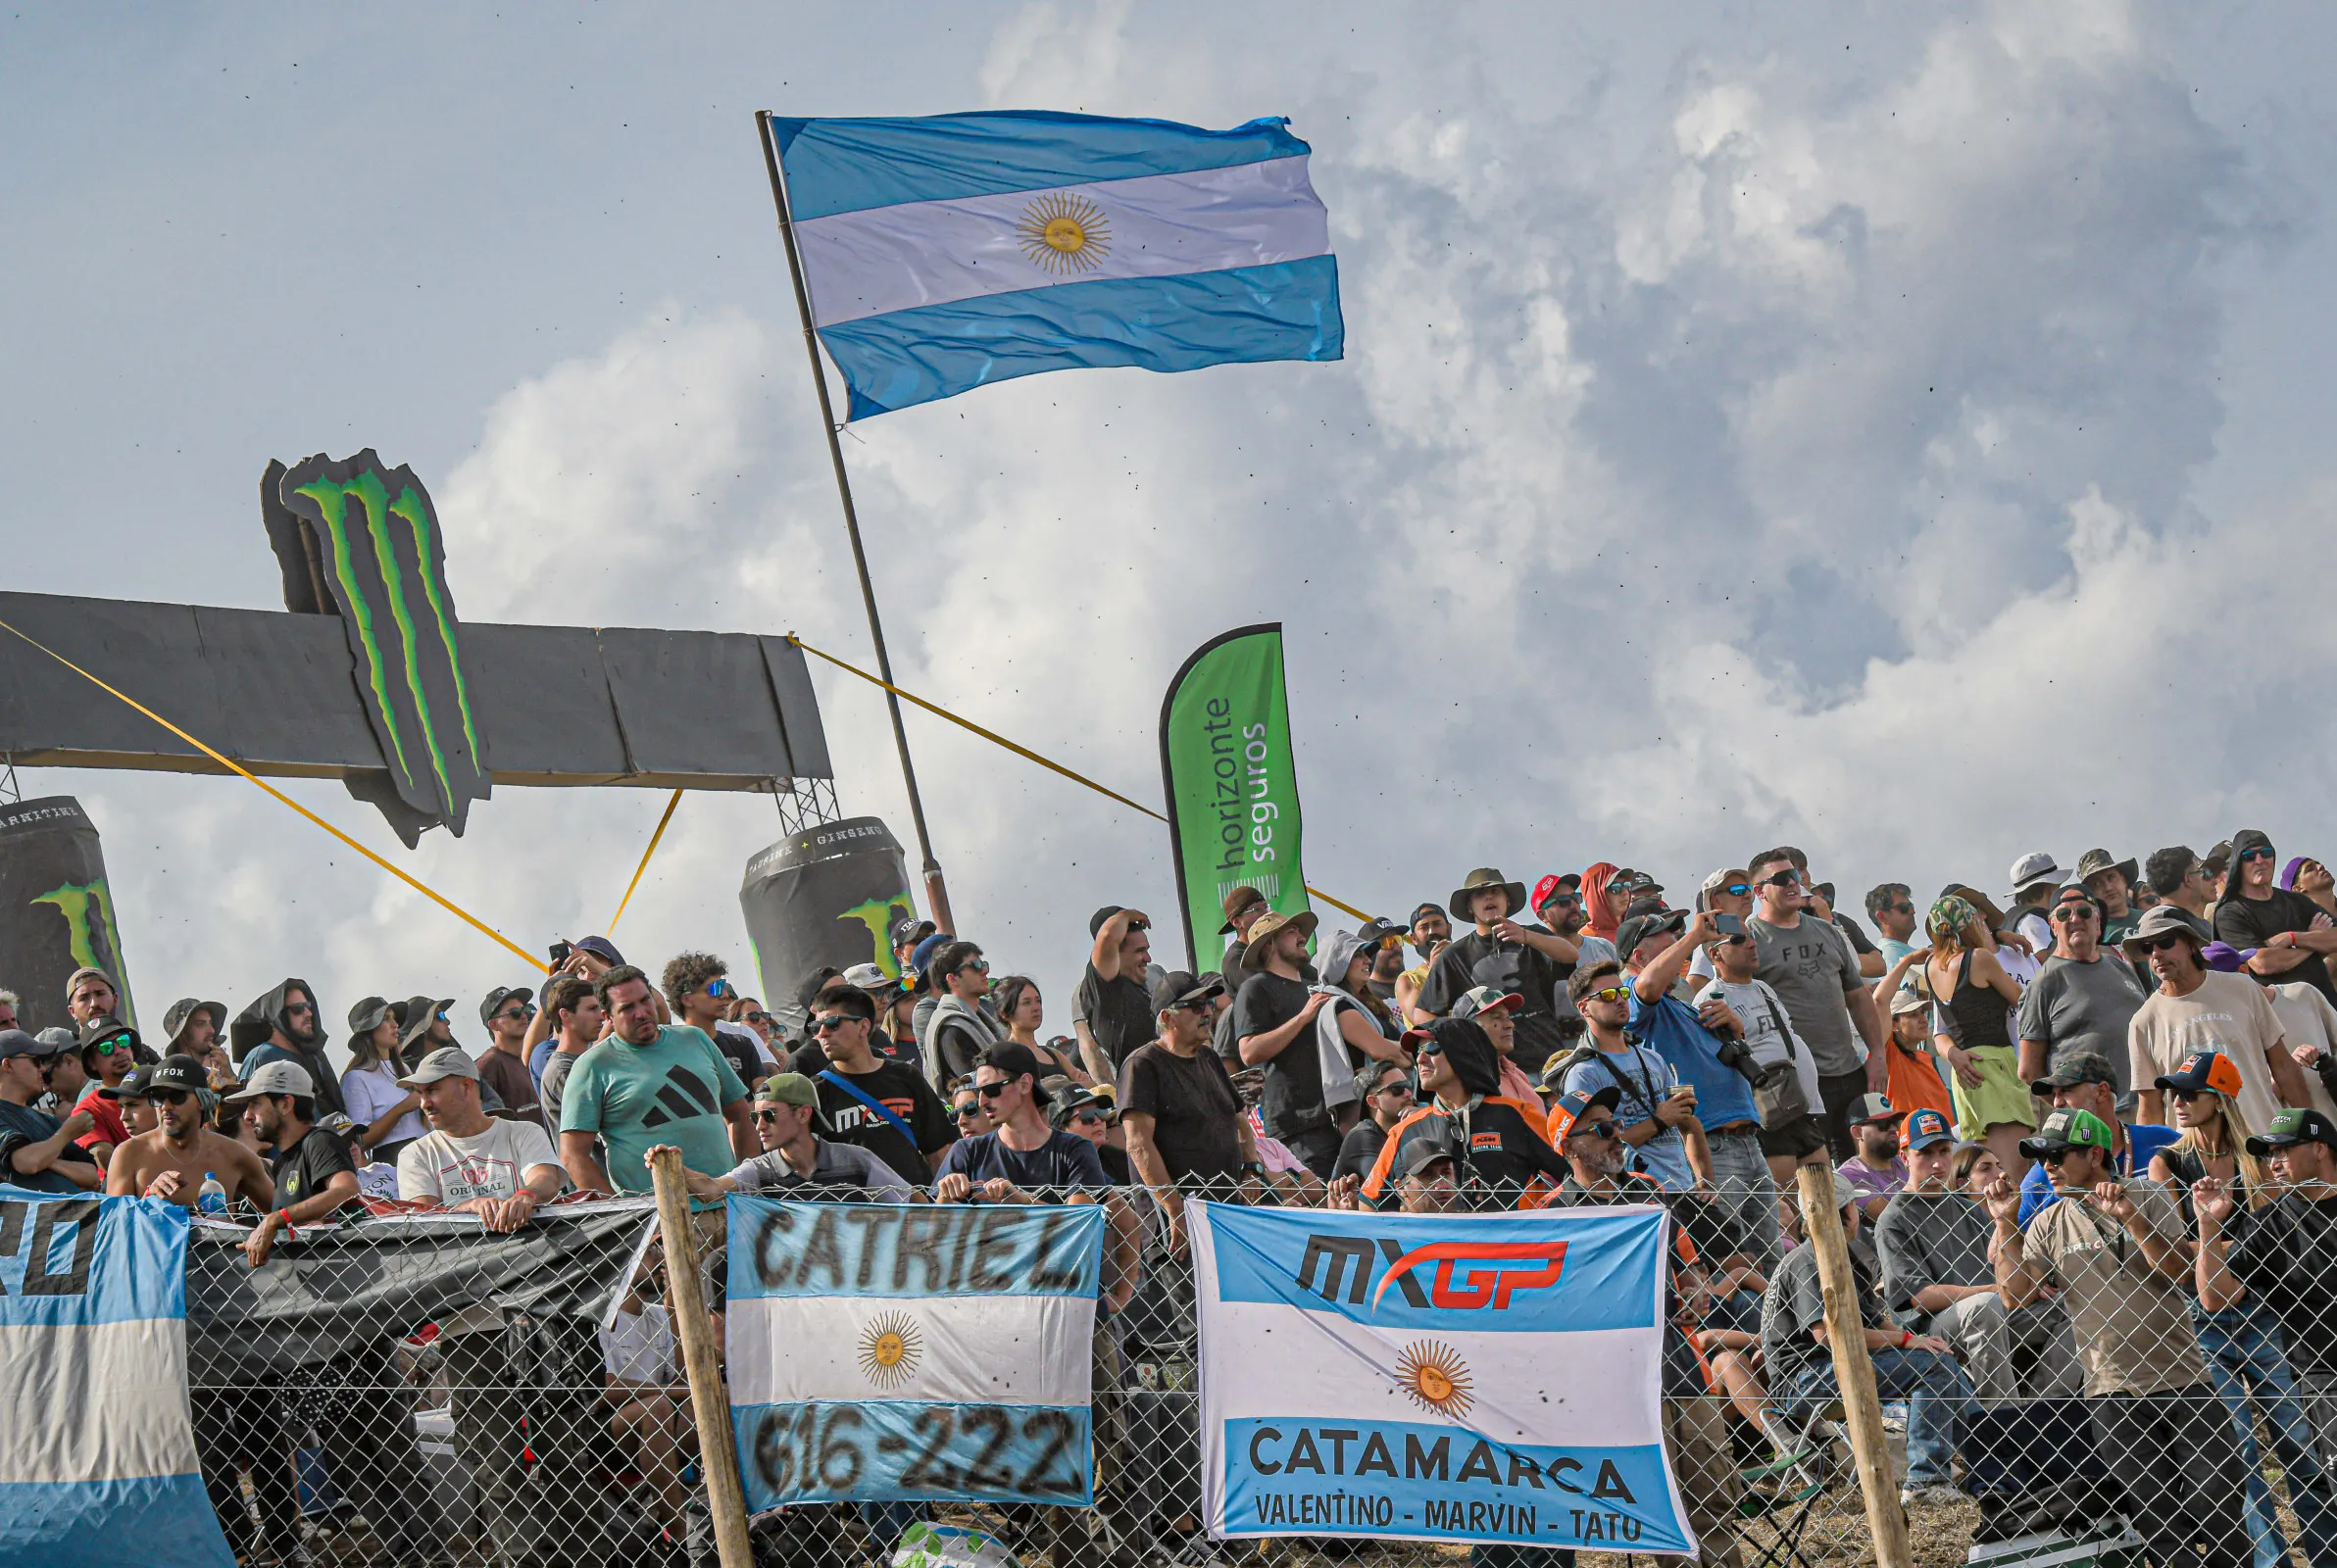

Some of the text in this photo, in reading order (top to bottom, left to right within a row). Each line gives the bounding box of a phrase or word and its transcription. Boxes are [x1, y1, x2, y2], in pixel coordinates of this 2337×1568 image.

[1204, 697, 1246, 870] horizonte
[1242, 722, 1279, 862] seguros
[817, 825, 883, 846] GINSENG
[1782, 942, 1827, 962] FOX
[163, 1068, 185, 1077] FOX
[754, 1206, 1084, 1291] CATRIEL
[1294, 1234, 1569, 1317] MXGP
[755, 1403, 1086, 1494] 616-222
[1249, 1427, 1638, 1504] CATAMARCA
[1256, 1493, 1394, 1527] VALENTINO
[1424, 1499, 1537, 1536] MARVIN
[1569, 1508, 1644, 1543] TATO
